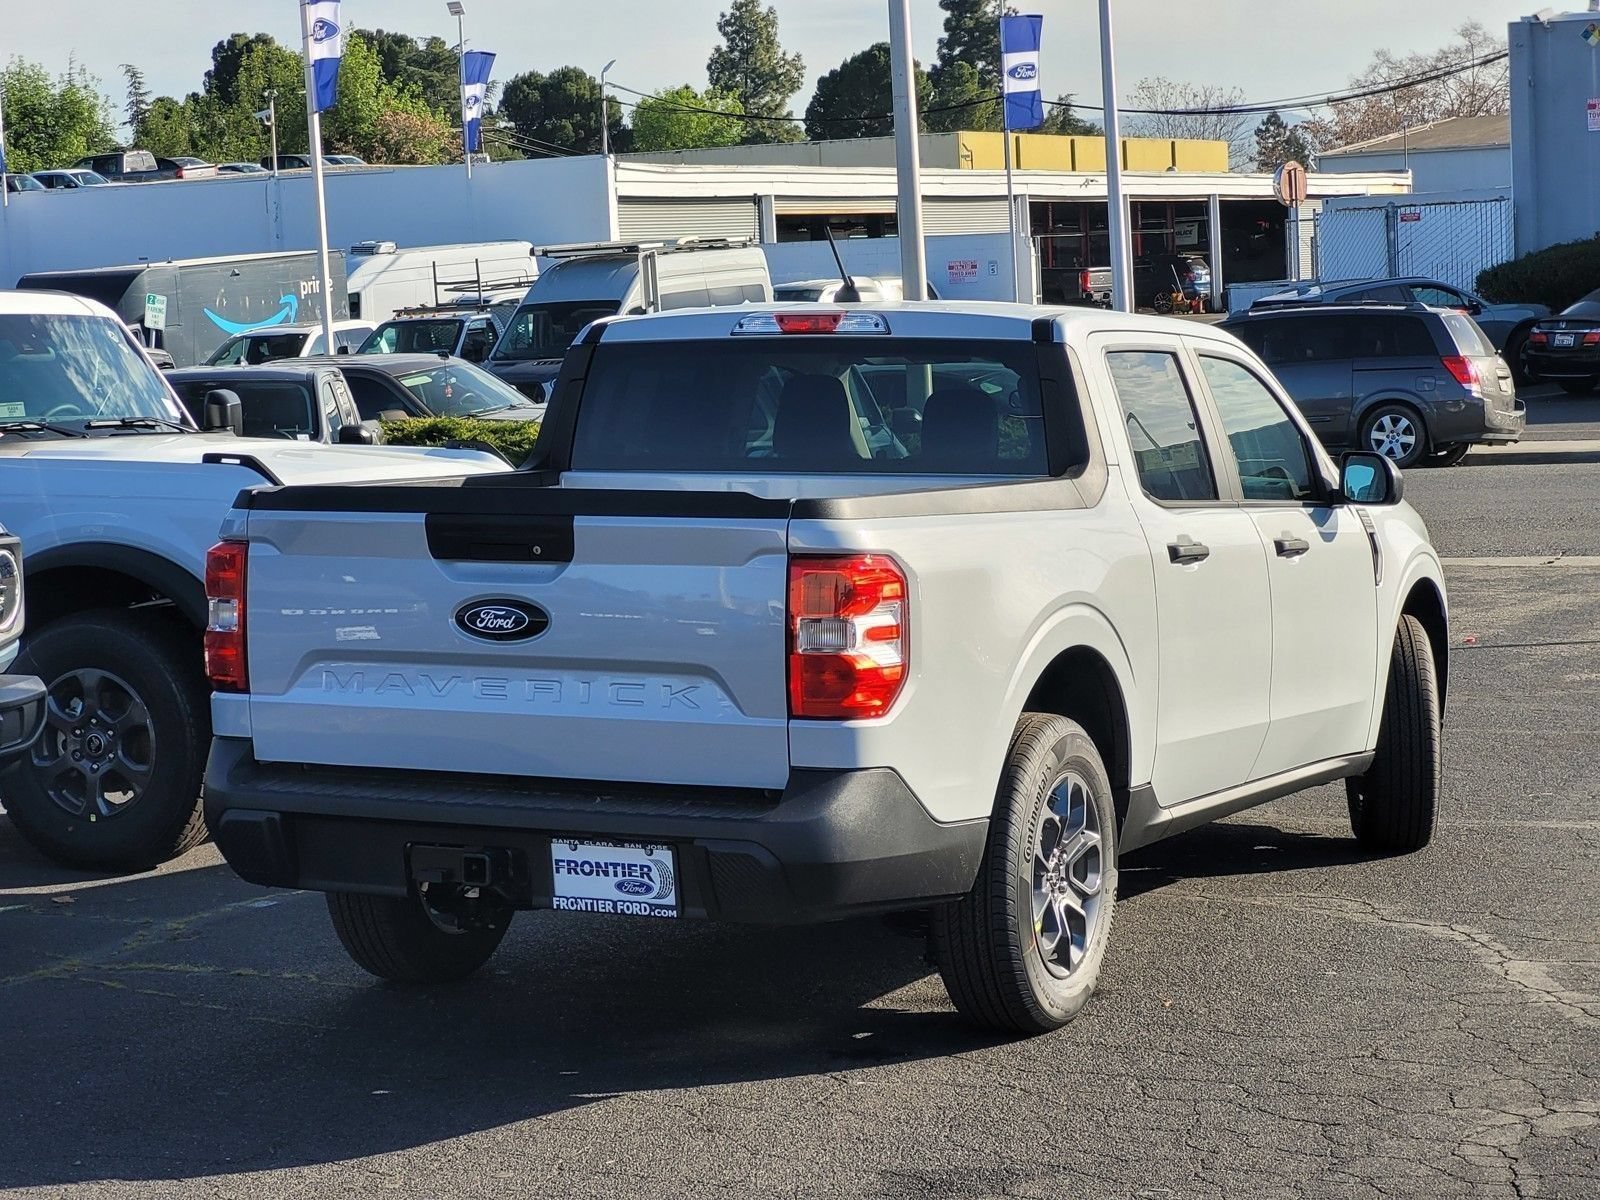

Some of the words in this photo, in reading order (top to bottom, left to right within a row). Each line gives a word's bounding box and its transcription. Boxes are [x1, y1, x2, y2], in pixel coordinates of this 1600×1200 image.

[1015, 65, 1036, 78] Ford
[300, 275, 334, 299] prie
[476, 609, 516, 629] Ford
[321, 670, 703, 710] MAVERICK
[554, 859, 657, 886] FRONTIER
[621, 881, 647, 894] Ford
[552, 897, 615, 914] FRONTIER
